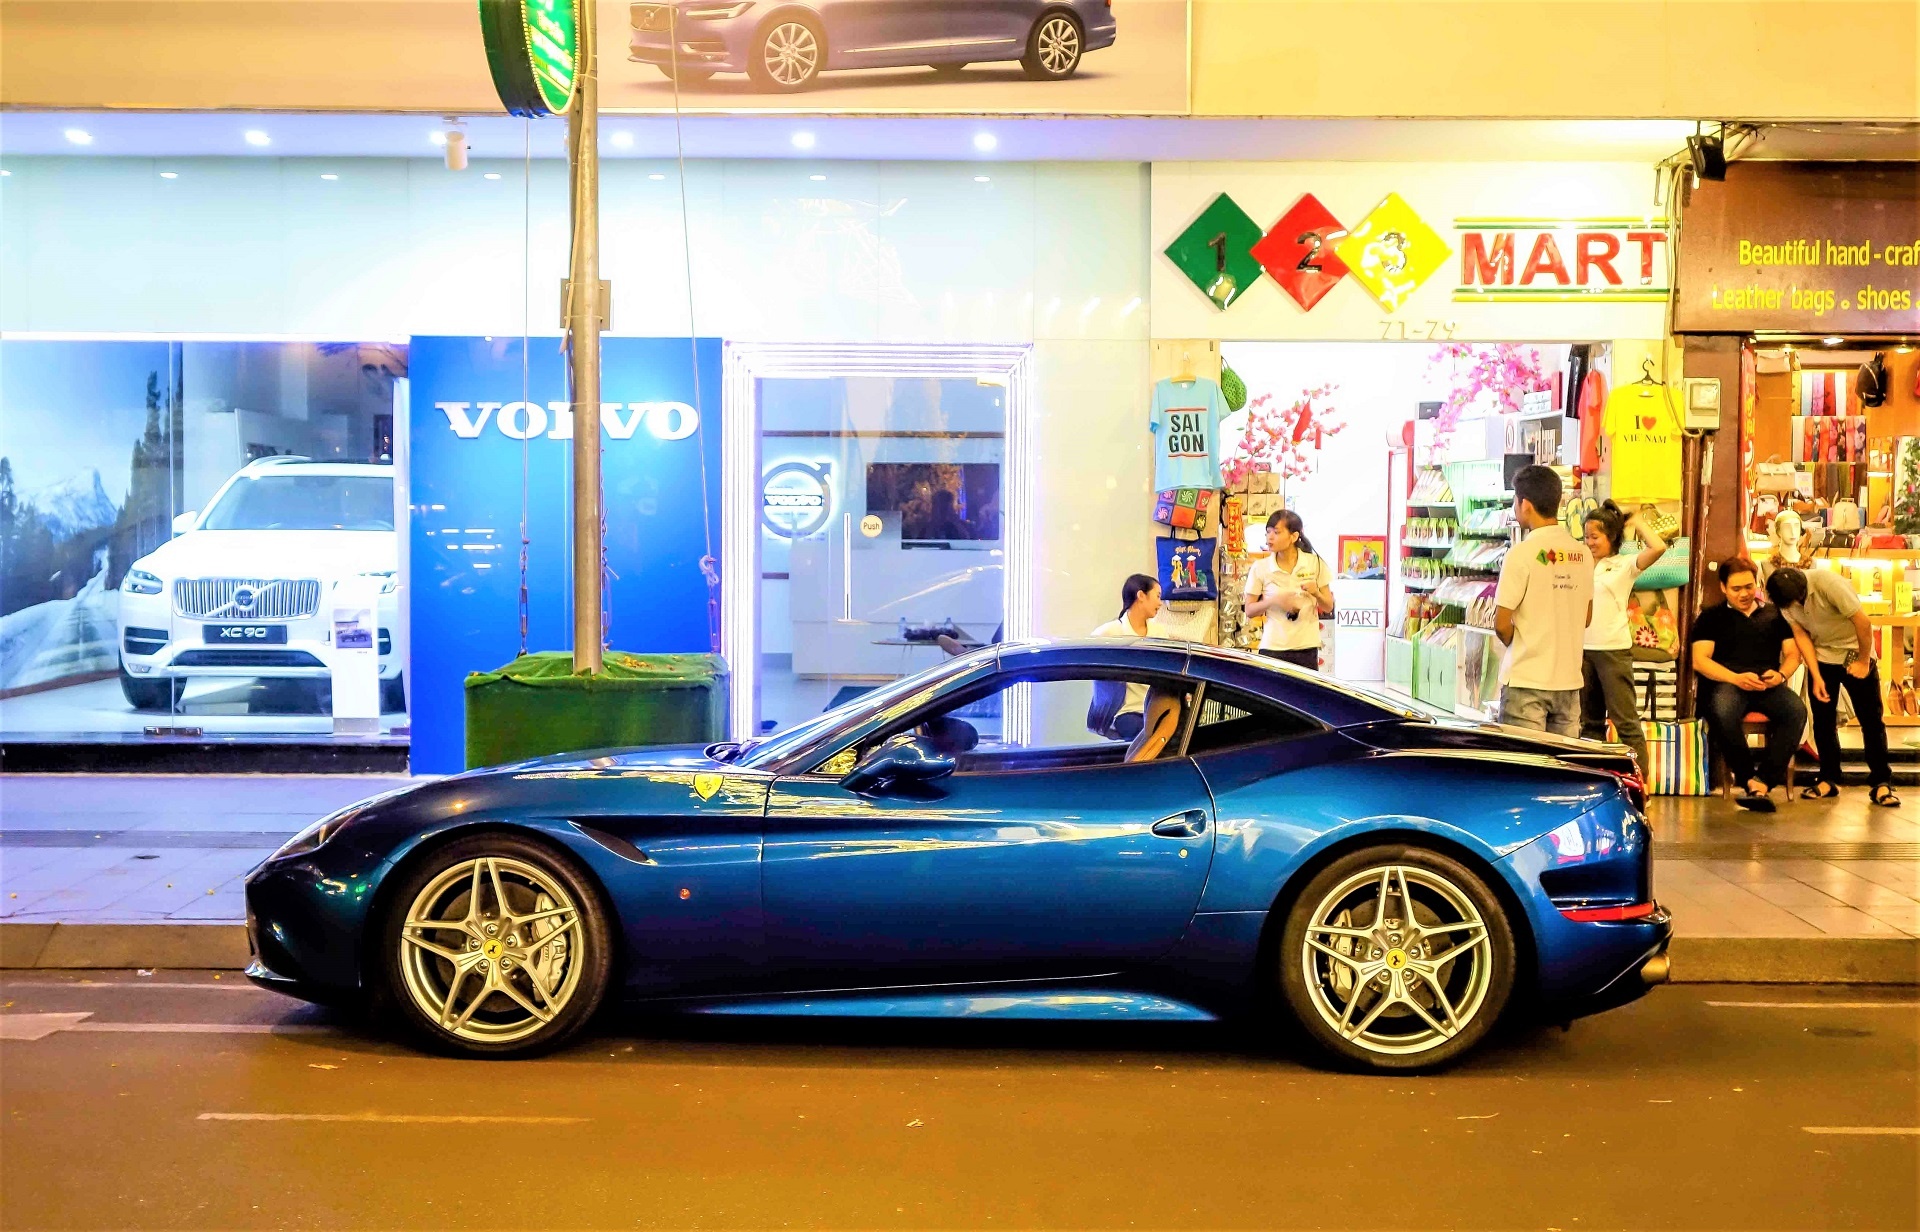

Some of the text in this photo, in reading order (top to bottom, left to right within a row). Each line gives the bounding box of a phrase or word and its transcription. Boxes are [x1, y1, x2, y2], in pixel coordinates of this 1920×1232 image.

[1207, 231, 1669, 286] 1 2 3 MART
[1738, 239, 1821, 266] Beautiful
[1711, 283, 1912, 316] Leather bags shoes
[1170, 413, 1200, 433] SAI
[1168, 434, 1205, 453] GON
[1645, 434, 1667, 444] NAM
[863, 521, 880, 530] Push
[1336, 610, 1384, 625] MART
